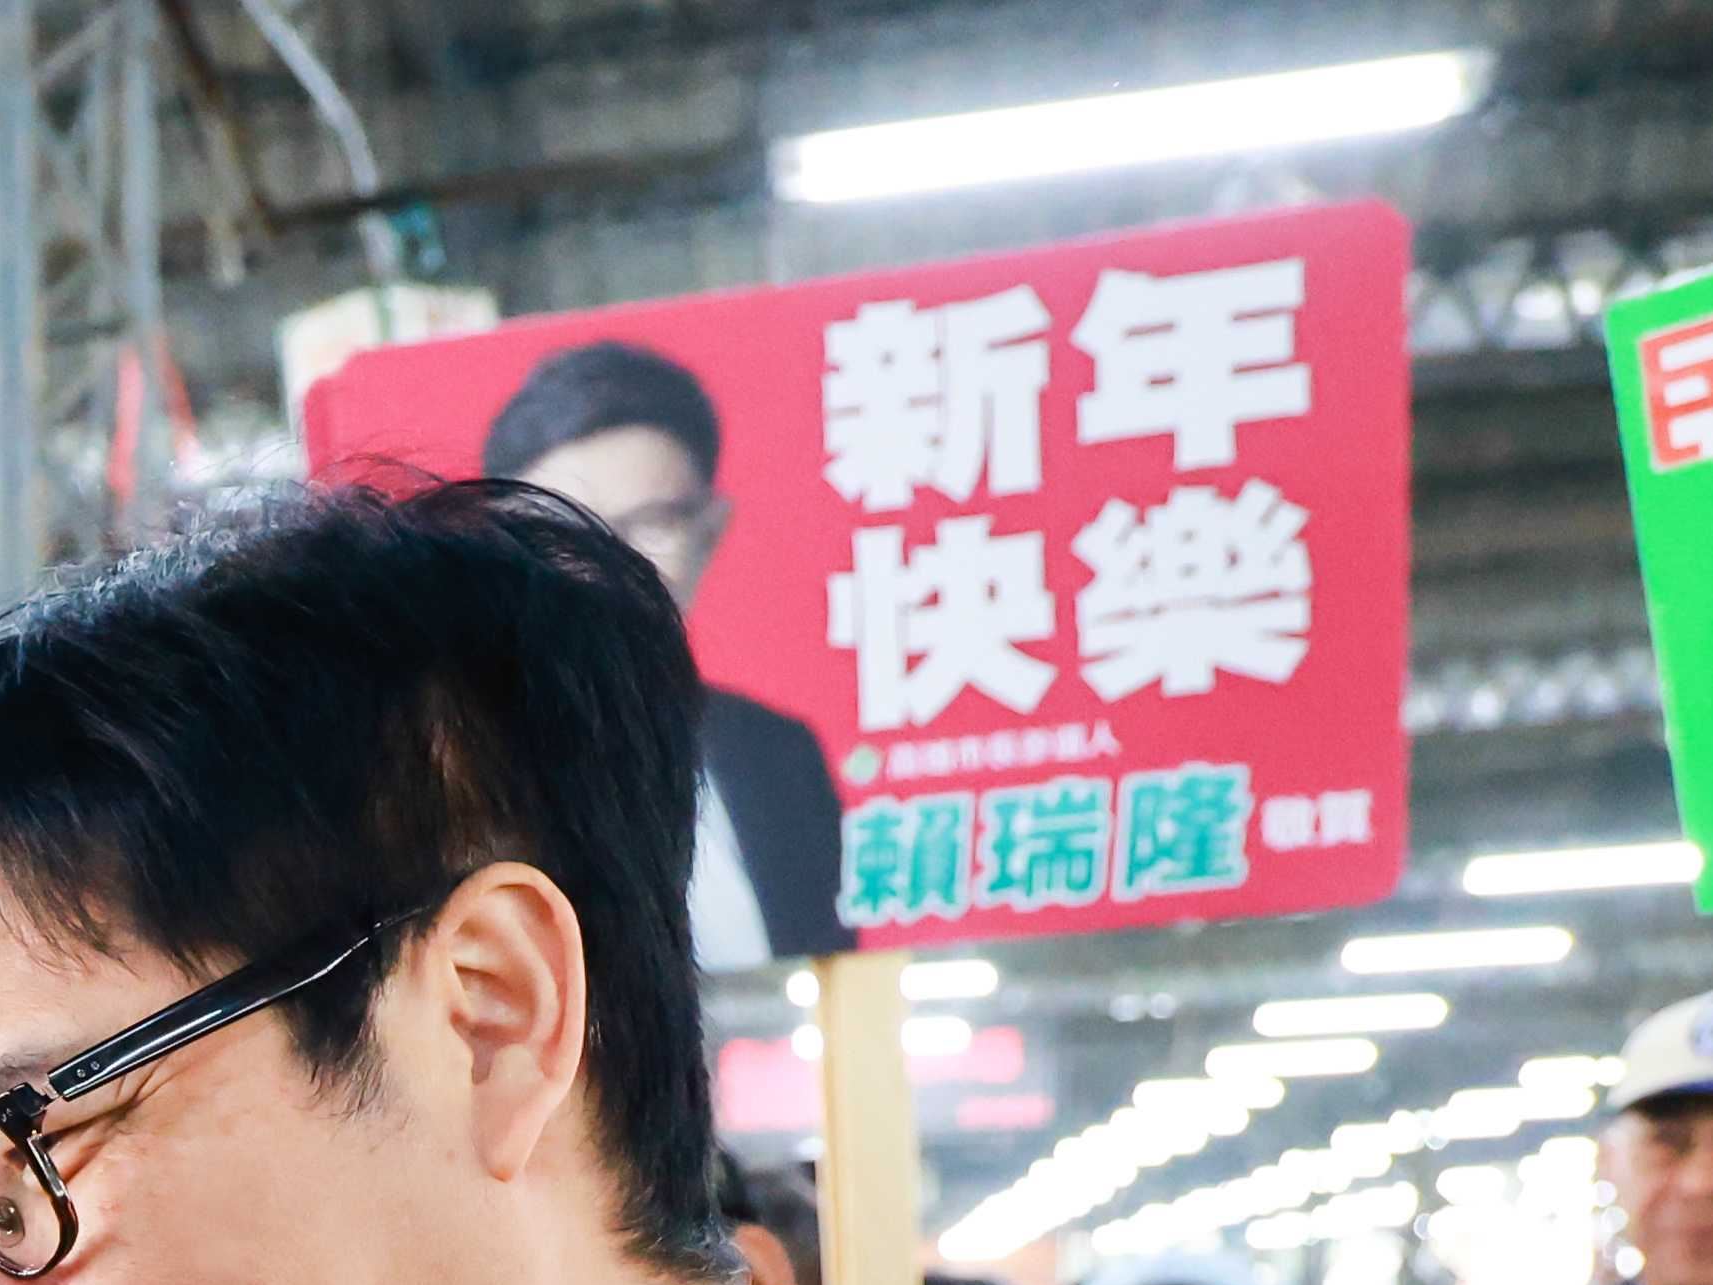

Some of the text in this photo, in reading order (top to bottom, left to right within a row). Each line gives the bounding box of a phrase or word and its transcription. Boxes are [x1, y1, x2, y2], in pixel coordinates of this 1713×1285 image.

[822, 258, 1311, 513] 新年
[826, 478, 1312, 732] 快樂
[838, 760, 1254, 927] 賴瑞隆
